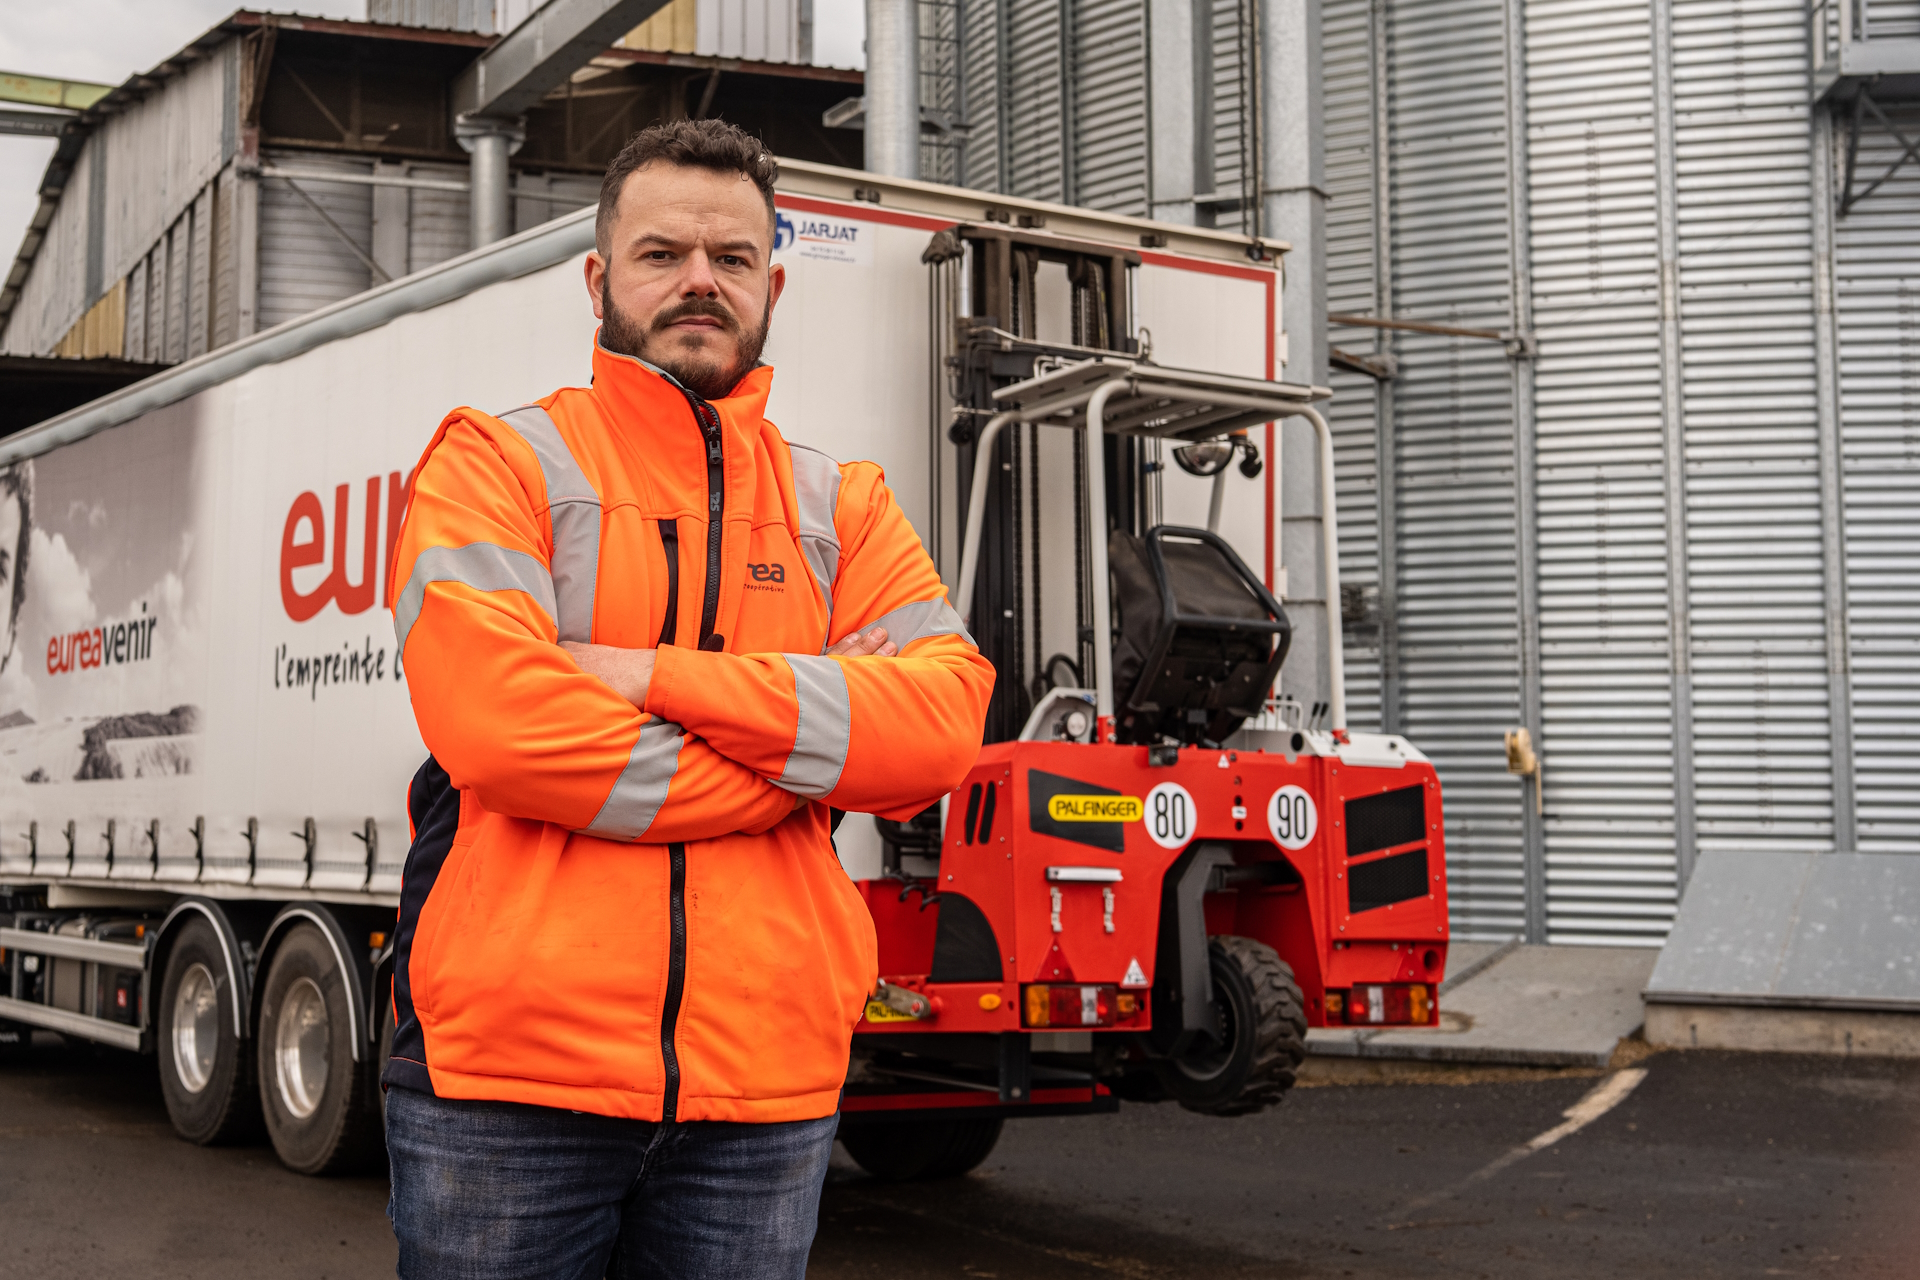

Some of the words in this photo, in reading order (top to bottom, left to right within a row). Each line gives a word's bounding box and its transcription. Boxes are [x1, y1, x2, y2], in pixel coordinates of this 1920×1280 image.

[798, 221, 858, 242] JARJAT
[280, 465, 417, 624] eur
[47, 601, 157, 676] eureavenir
[274, 634, 385, 702] l'empreinte
[1055, 800, 1138, 817] PALFINGER
[1155, 791, 1186, 839] 80
[1278, 794, 1308, 840] 90
